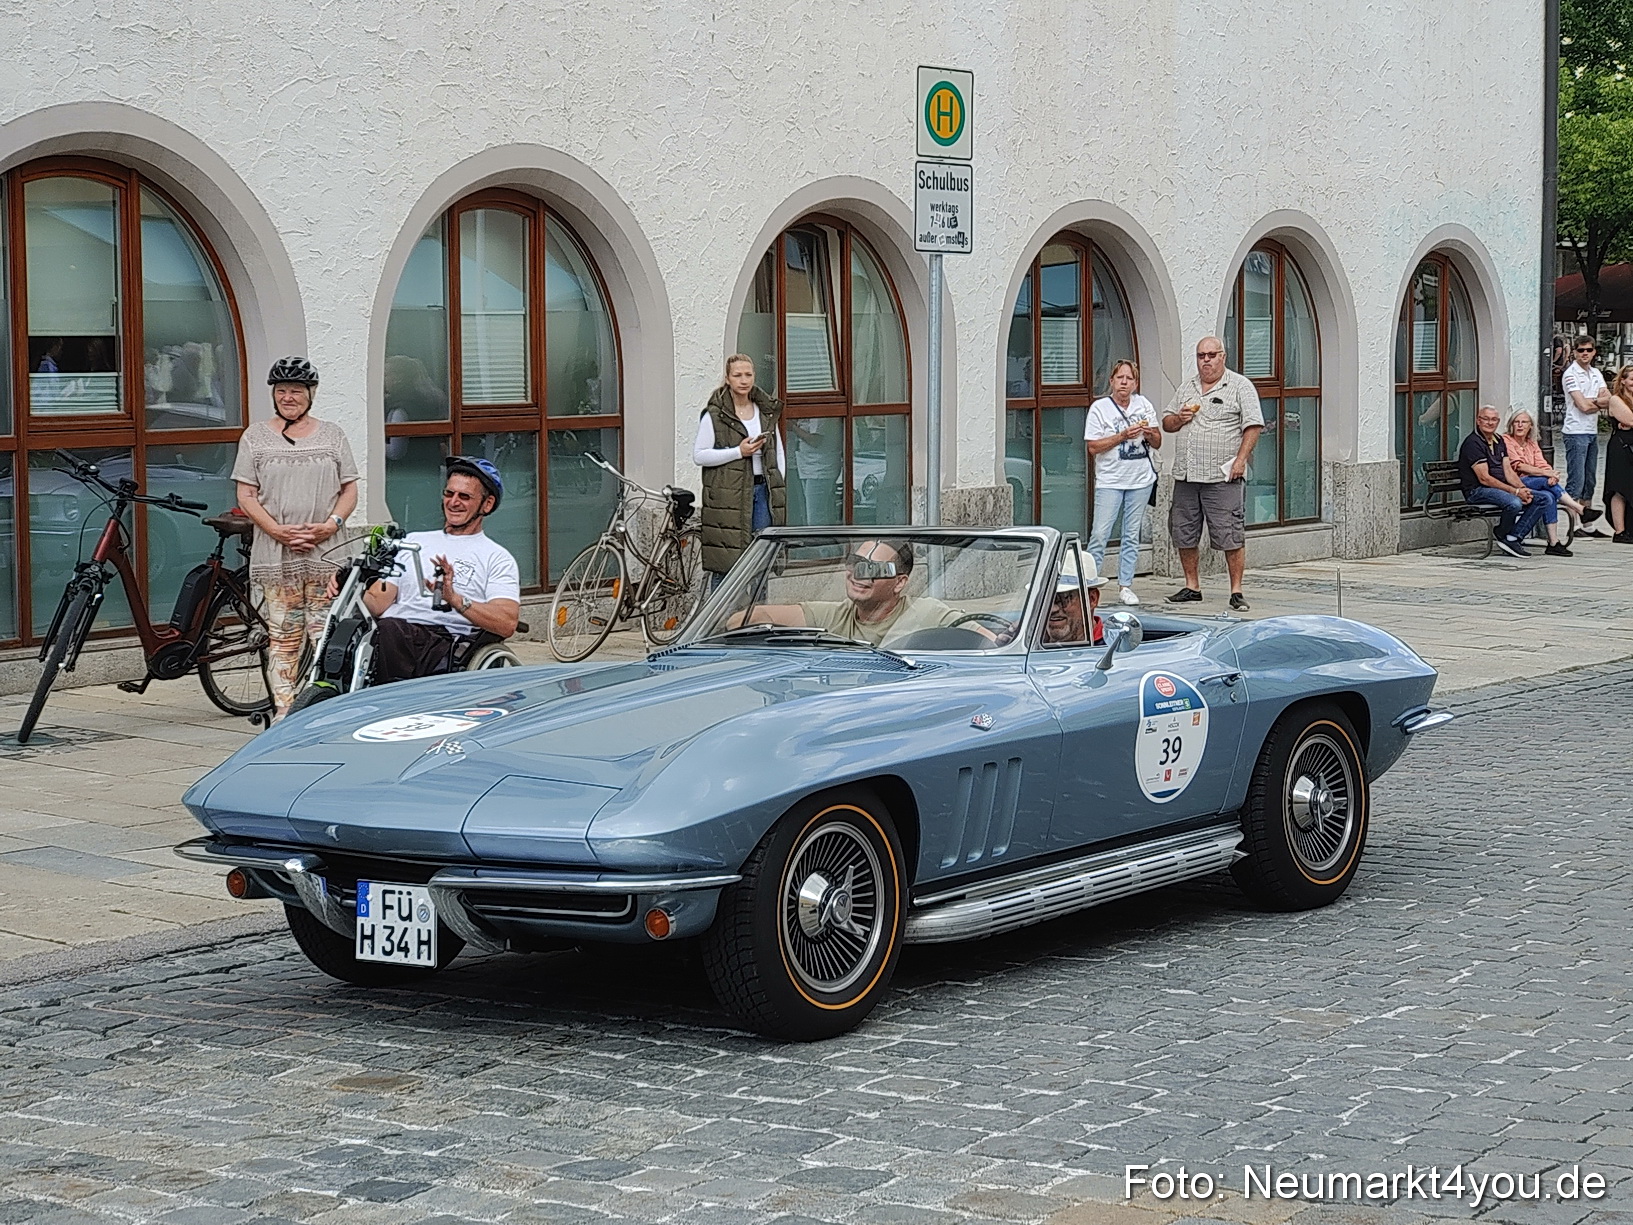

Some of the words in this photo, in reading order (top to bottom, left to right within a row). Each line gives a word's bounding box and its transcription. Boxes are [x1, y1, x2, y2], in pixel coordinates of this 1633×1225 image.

[937, 95, 953, 132] H
[918, 169, 970, 193] Schulbus
[930, 201, 959, 217] werktags
[1159, 736, 1182, 766] 39
[361, 904, 367, 914] D
[381, 925, 410, 959] 34
